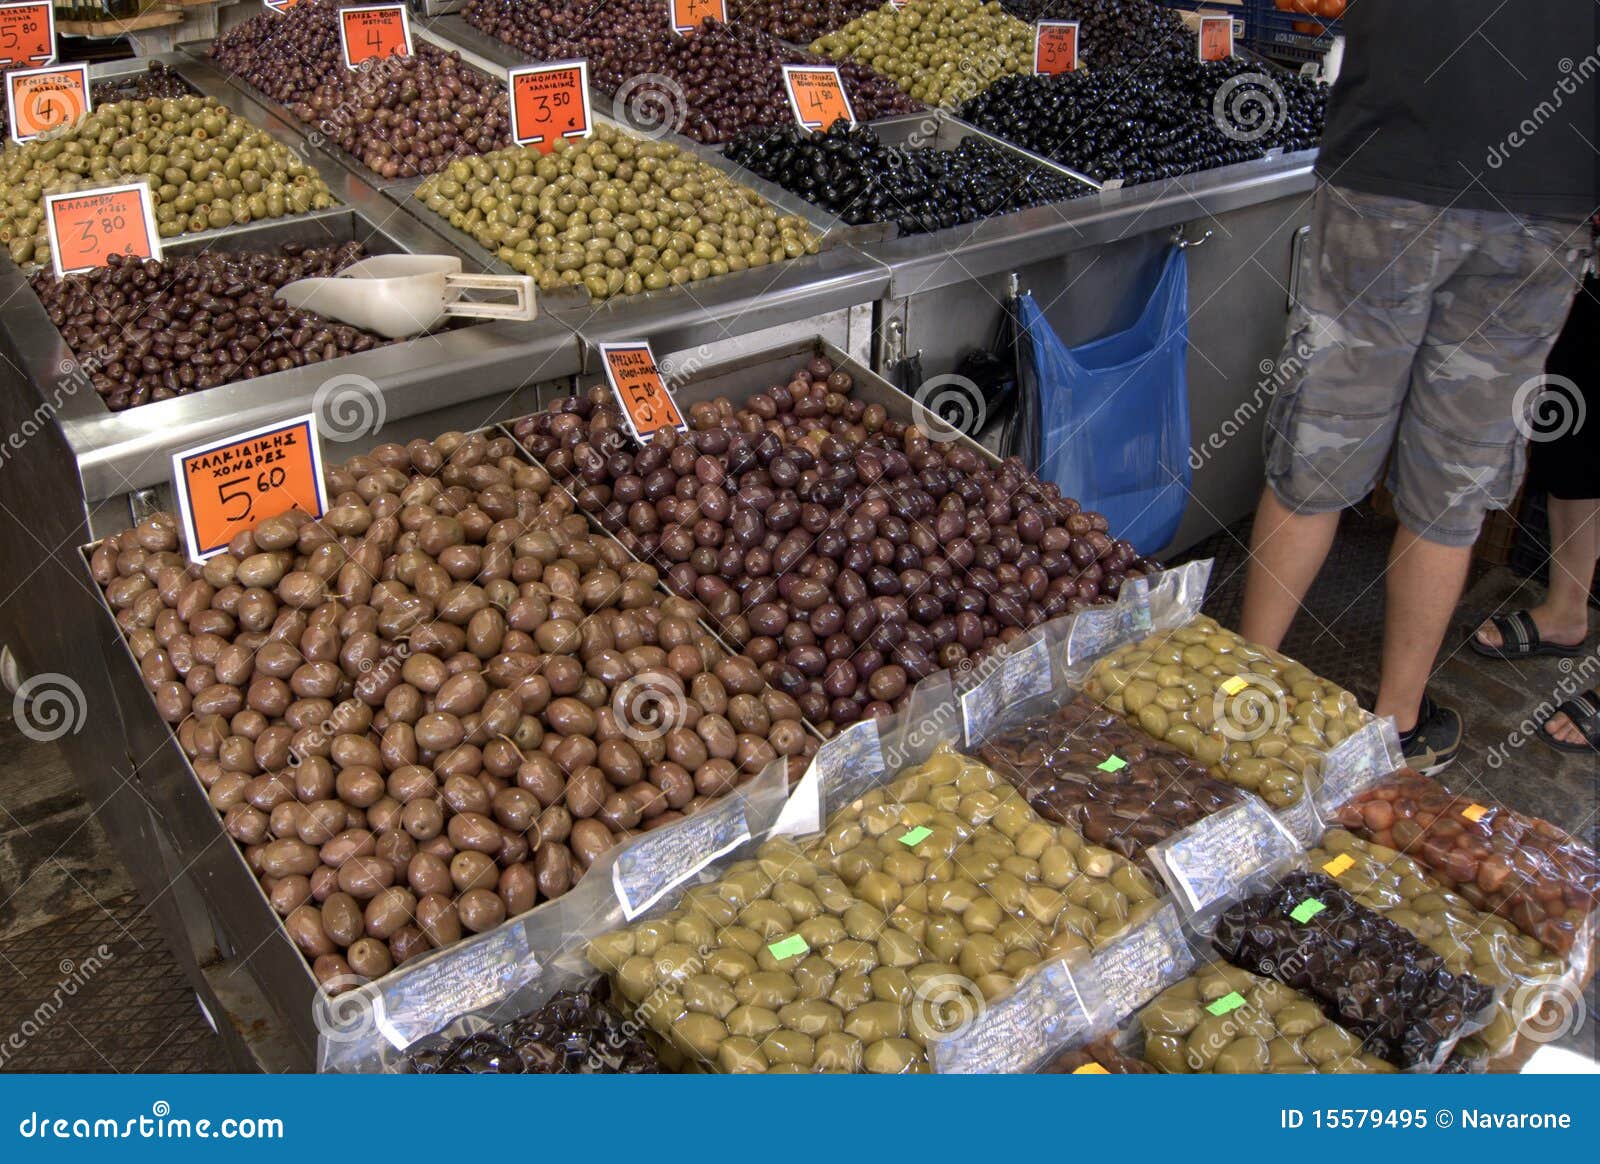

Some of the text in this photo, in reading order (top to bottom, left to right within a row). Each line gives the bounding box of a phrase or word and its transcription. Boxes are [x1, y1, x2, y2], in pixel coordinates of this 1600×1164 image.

[366, 28, 383, 52] 4
[36, 97, 53, 122] 4
[190, 432, 297, 473] ΧΑΛΚΙΔΙΚΗΣ
[213, 449, 286, 478] ΧΟΝΔΡΕΣ
